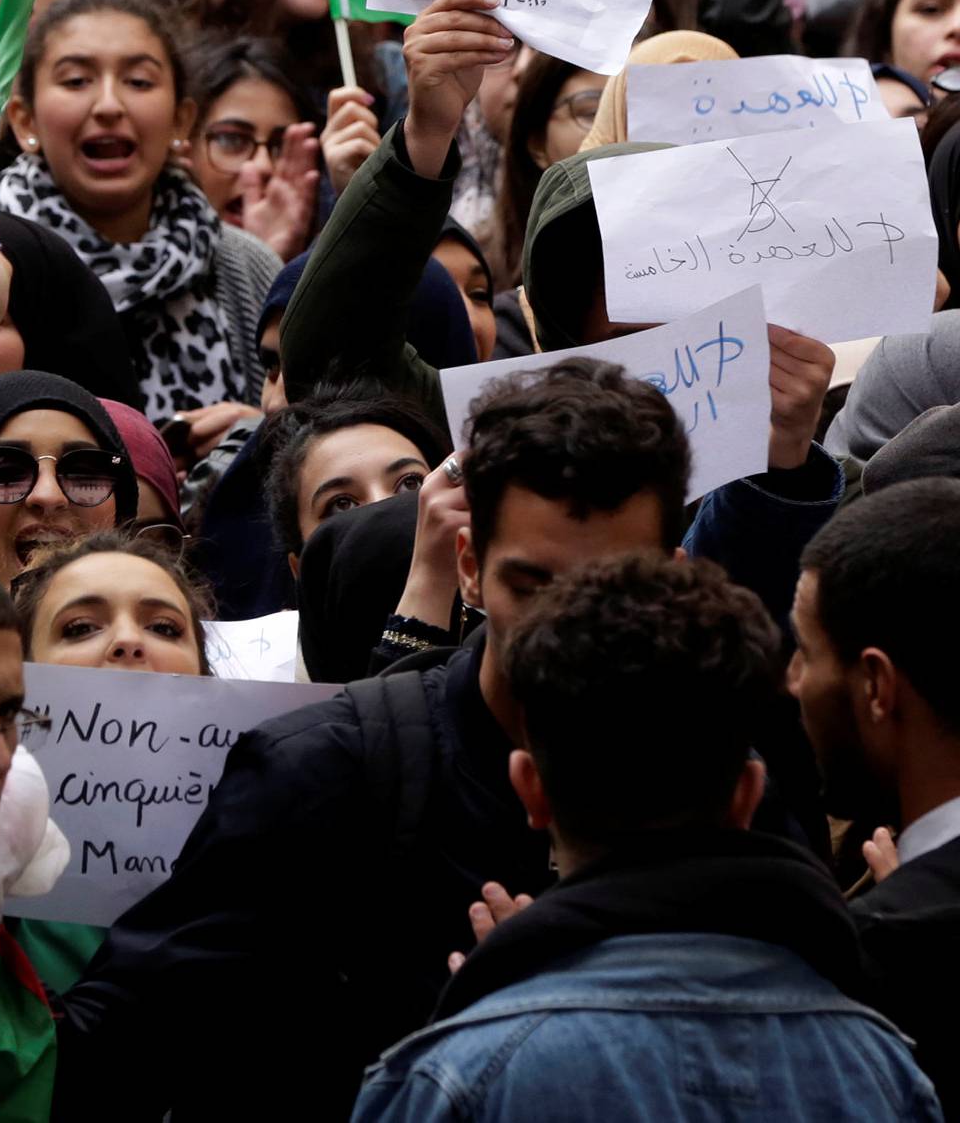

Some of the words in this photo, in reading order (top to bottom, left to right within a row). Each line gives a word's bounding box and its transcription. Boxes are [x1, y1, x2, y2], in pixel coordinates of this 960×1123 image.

[839, 72, 869, 120] لا
[624, 234, 712, 281] الخامسة
[856, 211, 906, 265] لا
[695, 320, 745, 388] لا
[81, 839, 179, 876] Man
